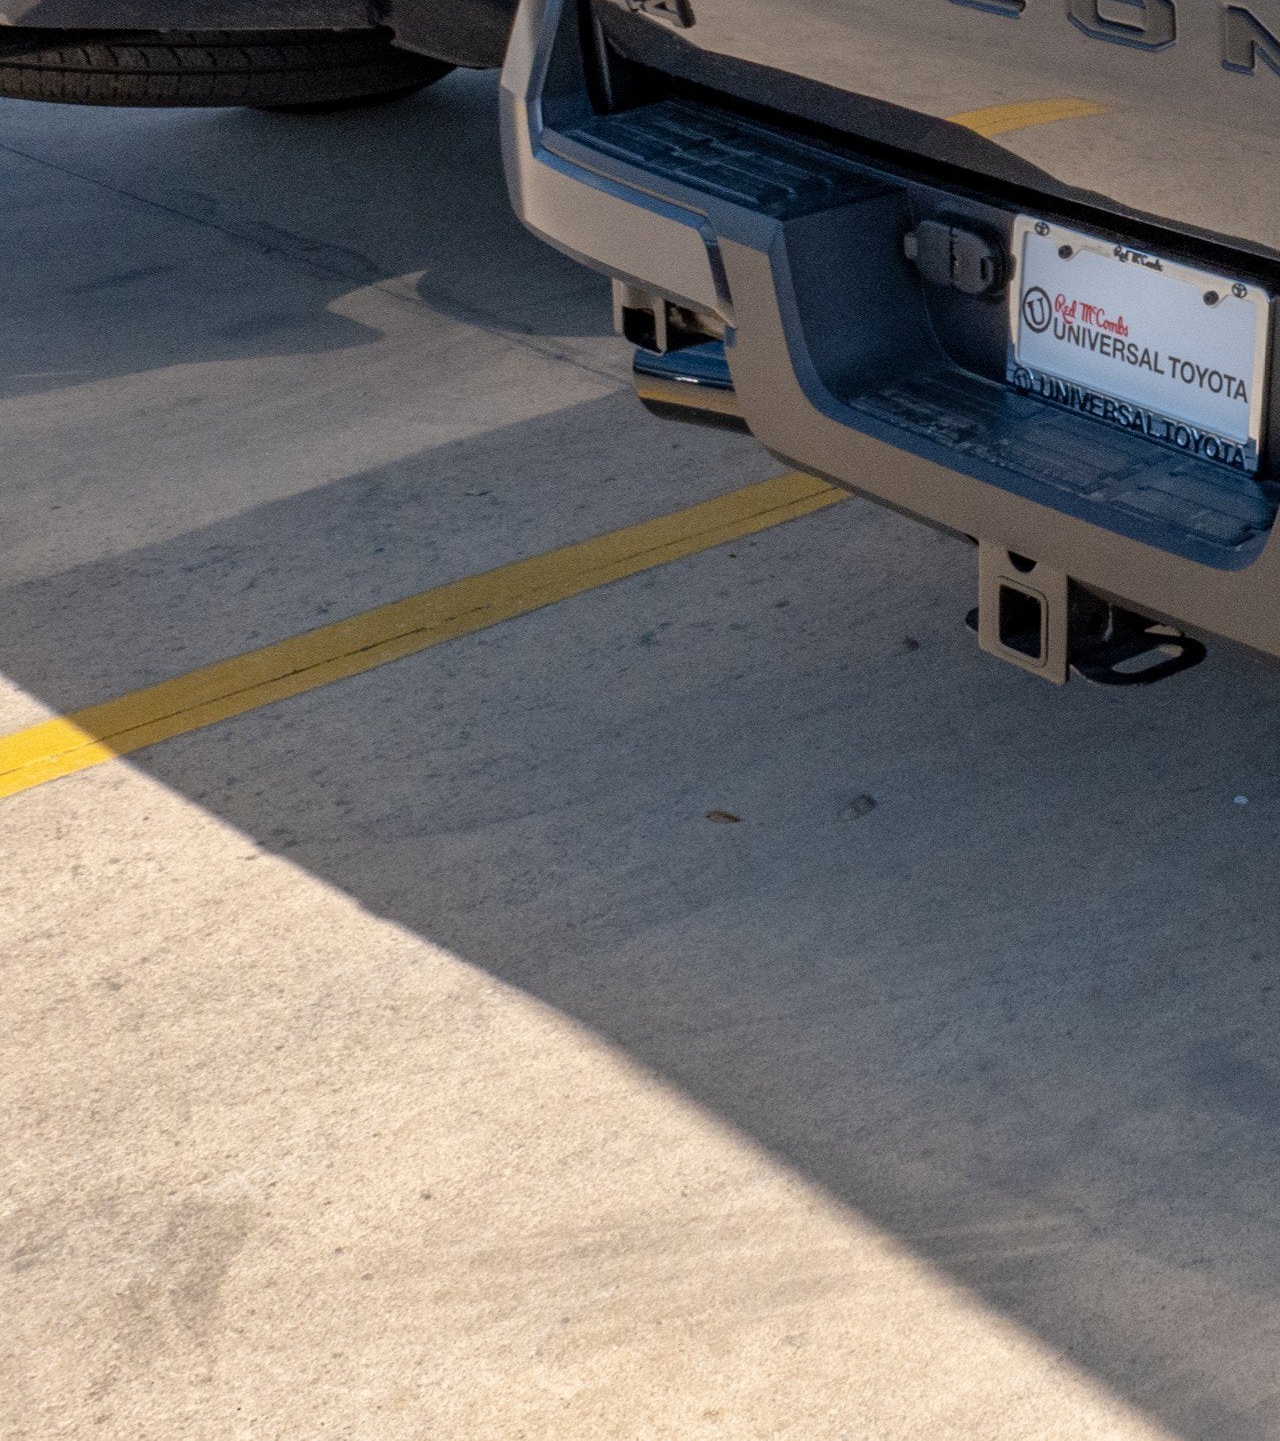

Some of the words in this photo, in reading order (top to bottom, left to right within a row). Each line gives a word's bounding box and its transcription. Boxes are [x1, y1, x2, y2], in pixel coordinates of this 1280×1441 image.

[1054, 293, 1077, 325] Red
[1078, 301, 1129, 338] McCombs
[1053, 317, 1165, 375] UNIVERSAL
[1168, 355, 1249, 404] TOYOTA
[1040, 375, 1164, 437] UNIVERSAL
[1163, 417, 1251, 471] TOYOTA
